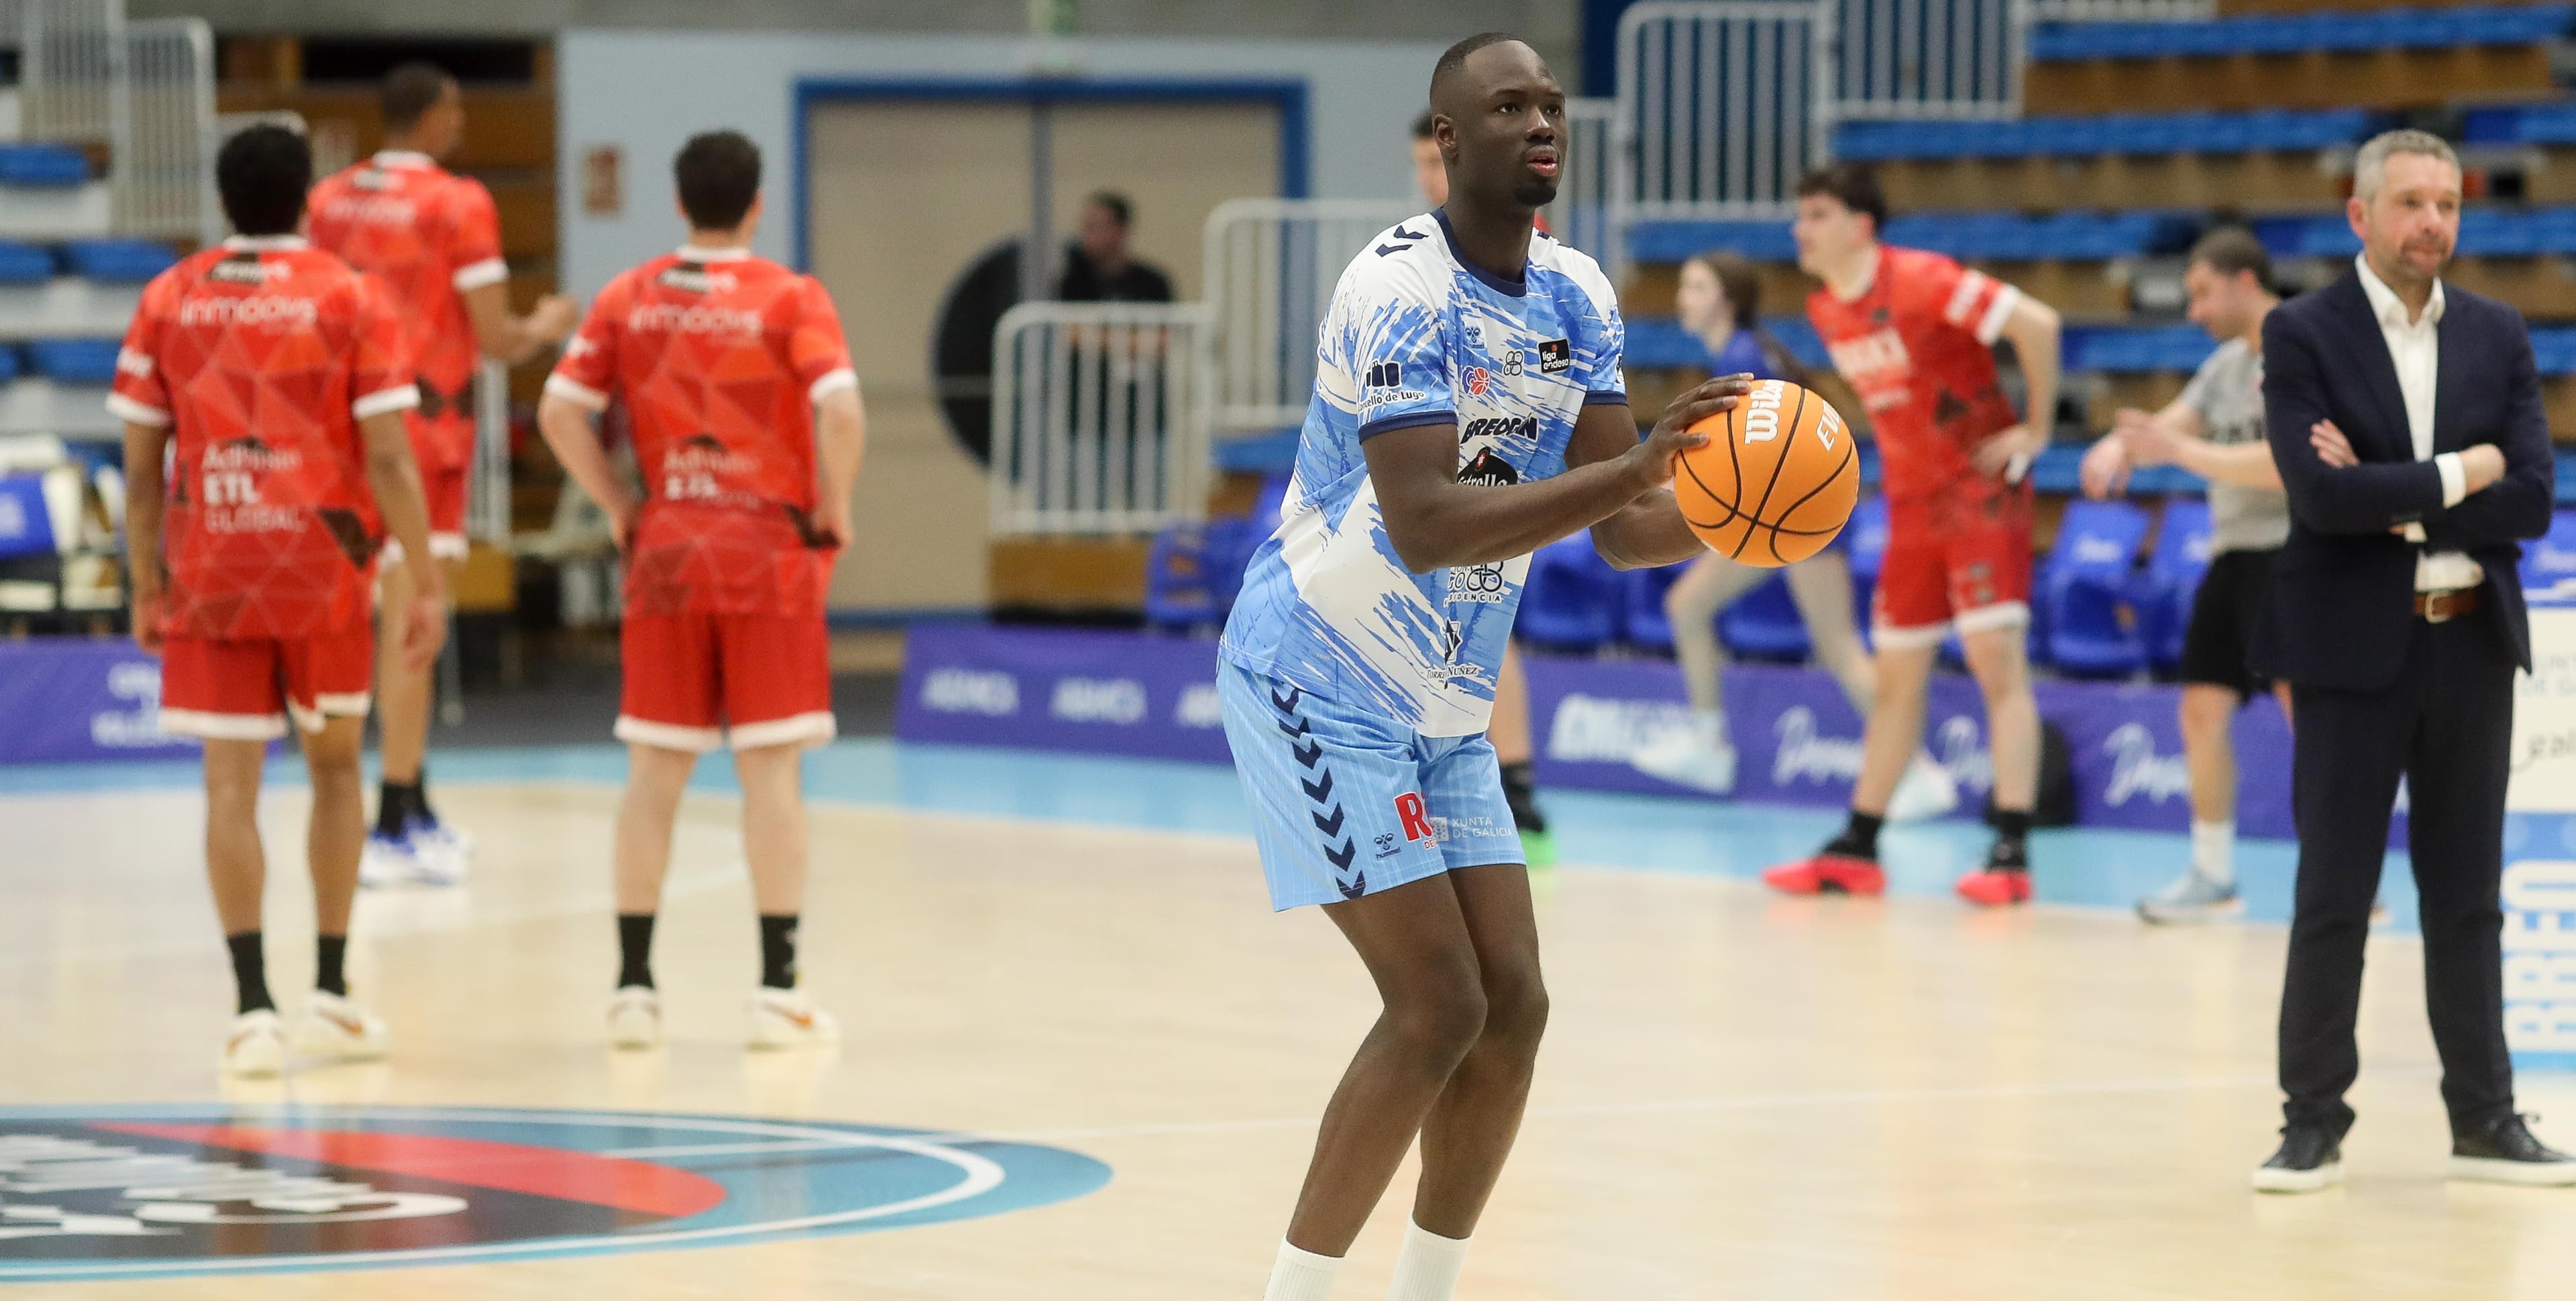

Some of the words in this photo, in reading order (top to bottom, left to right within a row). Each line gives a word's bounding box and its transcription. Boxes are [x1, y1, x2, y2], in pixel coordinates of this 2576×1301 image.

[1542, 351, 1556, 362] liga
[1543, 358, 1569, 370] endesa
[1385, 393, 1398, 402] de
[1401, 391, 1424, 400] Lugo
[1452, 817, 1493, 827] XUNTA
[1453, 829, 1468, 837] DE
[1472, 827, 1513, 837] GALICIA
